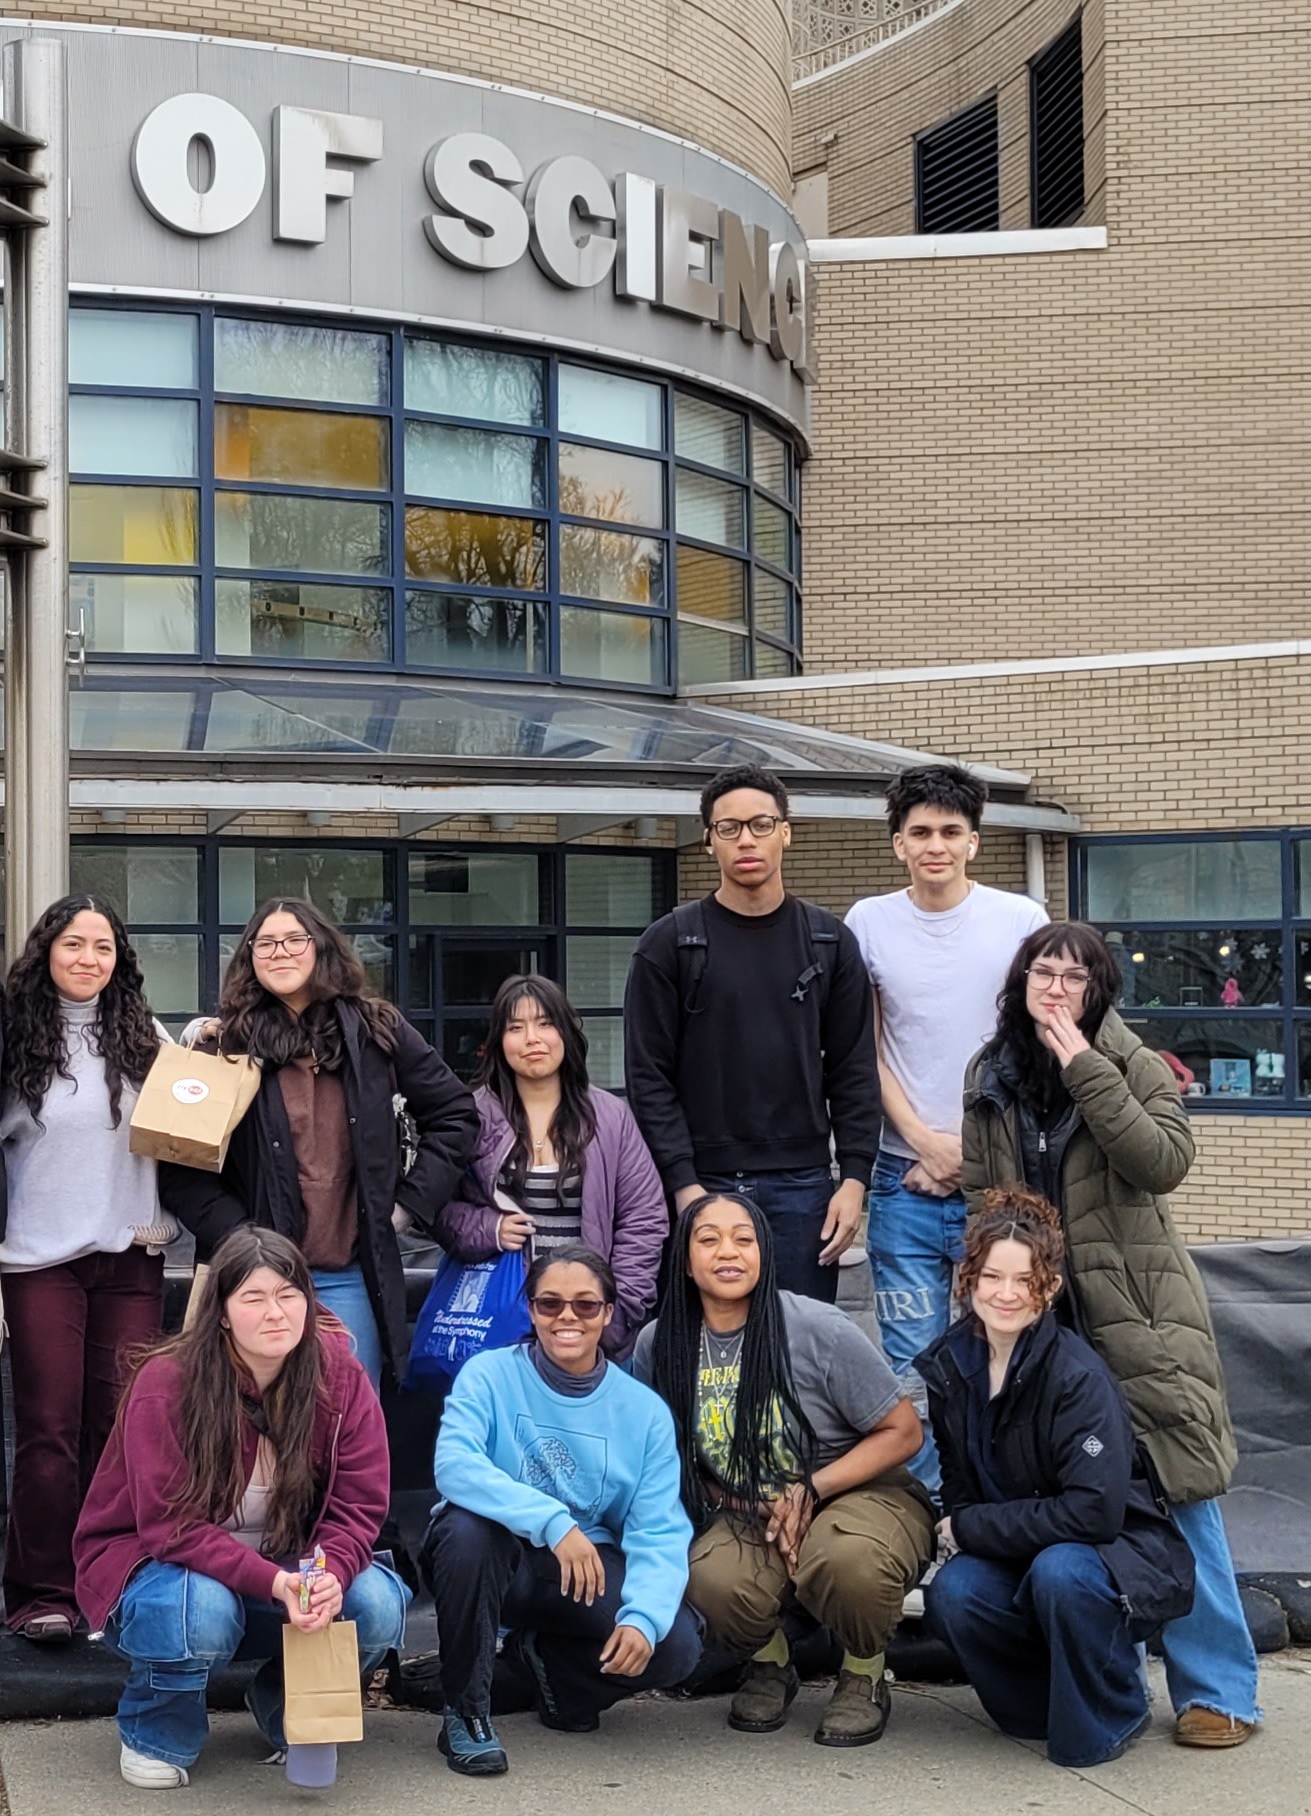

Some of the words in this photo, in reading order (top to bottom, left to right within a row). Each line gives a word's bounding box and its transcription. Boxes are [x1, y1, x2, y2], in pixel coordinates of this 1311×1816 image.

[131, 92, 383, 246] OF
[423, 131, 816, 385] SCIENC
[448, 1326, 487, 1342] Symphony
